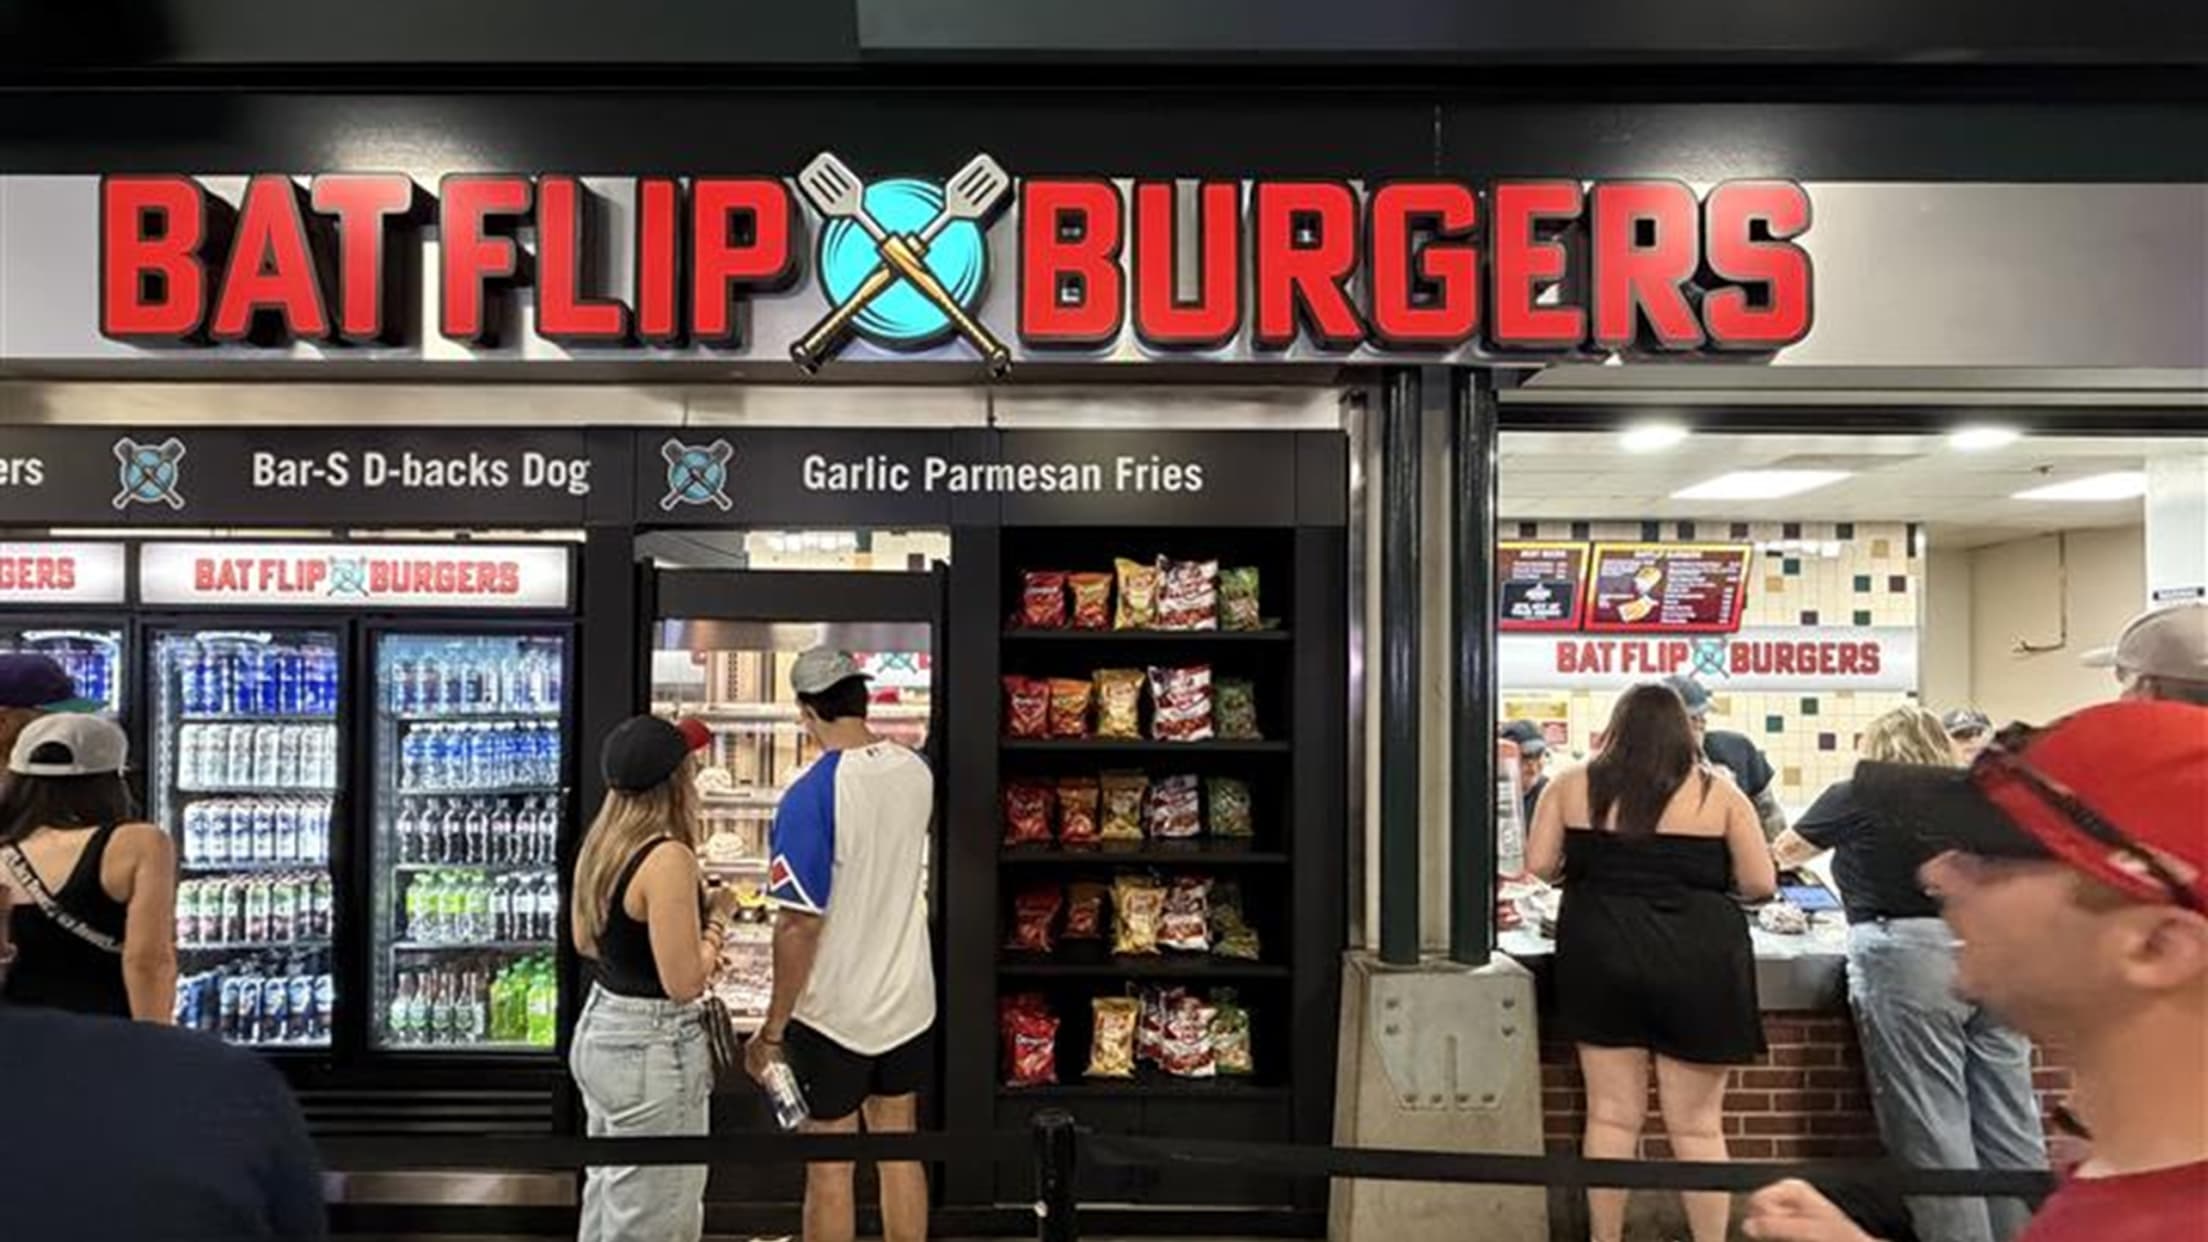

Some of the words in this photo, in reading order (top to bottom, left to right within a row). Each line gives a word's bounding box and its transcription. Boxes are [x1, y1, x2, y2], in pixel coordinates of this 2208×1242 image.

[102, 174, 411, 338] BAT
[441, 175, 792, 337] FLIP
[1018, 179, 1811, 344] BURGERS
[252, 452, 349, 487] Bar-S
[363, 452, 509, 487] D-backs
[521, 452, 590, 495] Dog
[802, 454, 910, 491] Garlic
[924, 457, 1101, 491] Parmesan
[1115, 456, 1203, 491] Fries
[194, 558, 253, 591] BAT
[258, 558, 327, 592] FLIP
[368, 560, 520, 594] BURGERS
[1556, 641, 1618, 673] BAT
[1621, 641, 1688, 674] FLIP
[1729, 643, 1881, 675] BURGERS
